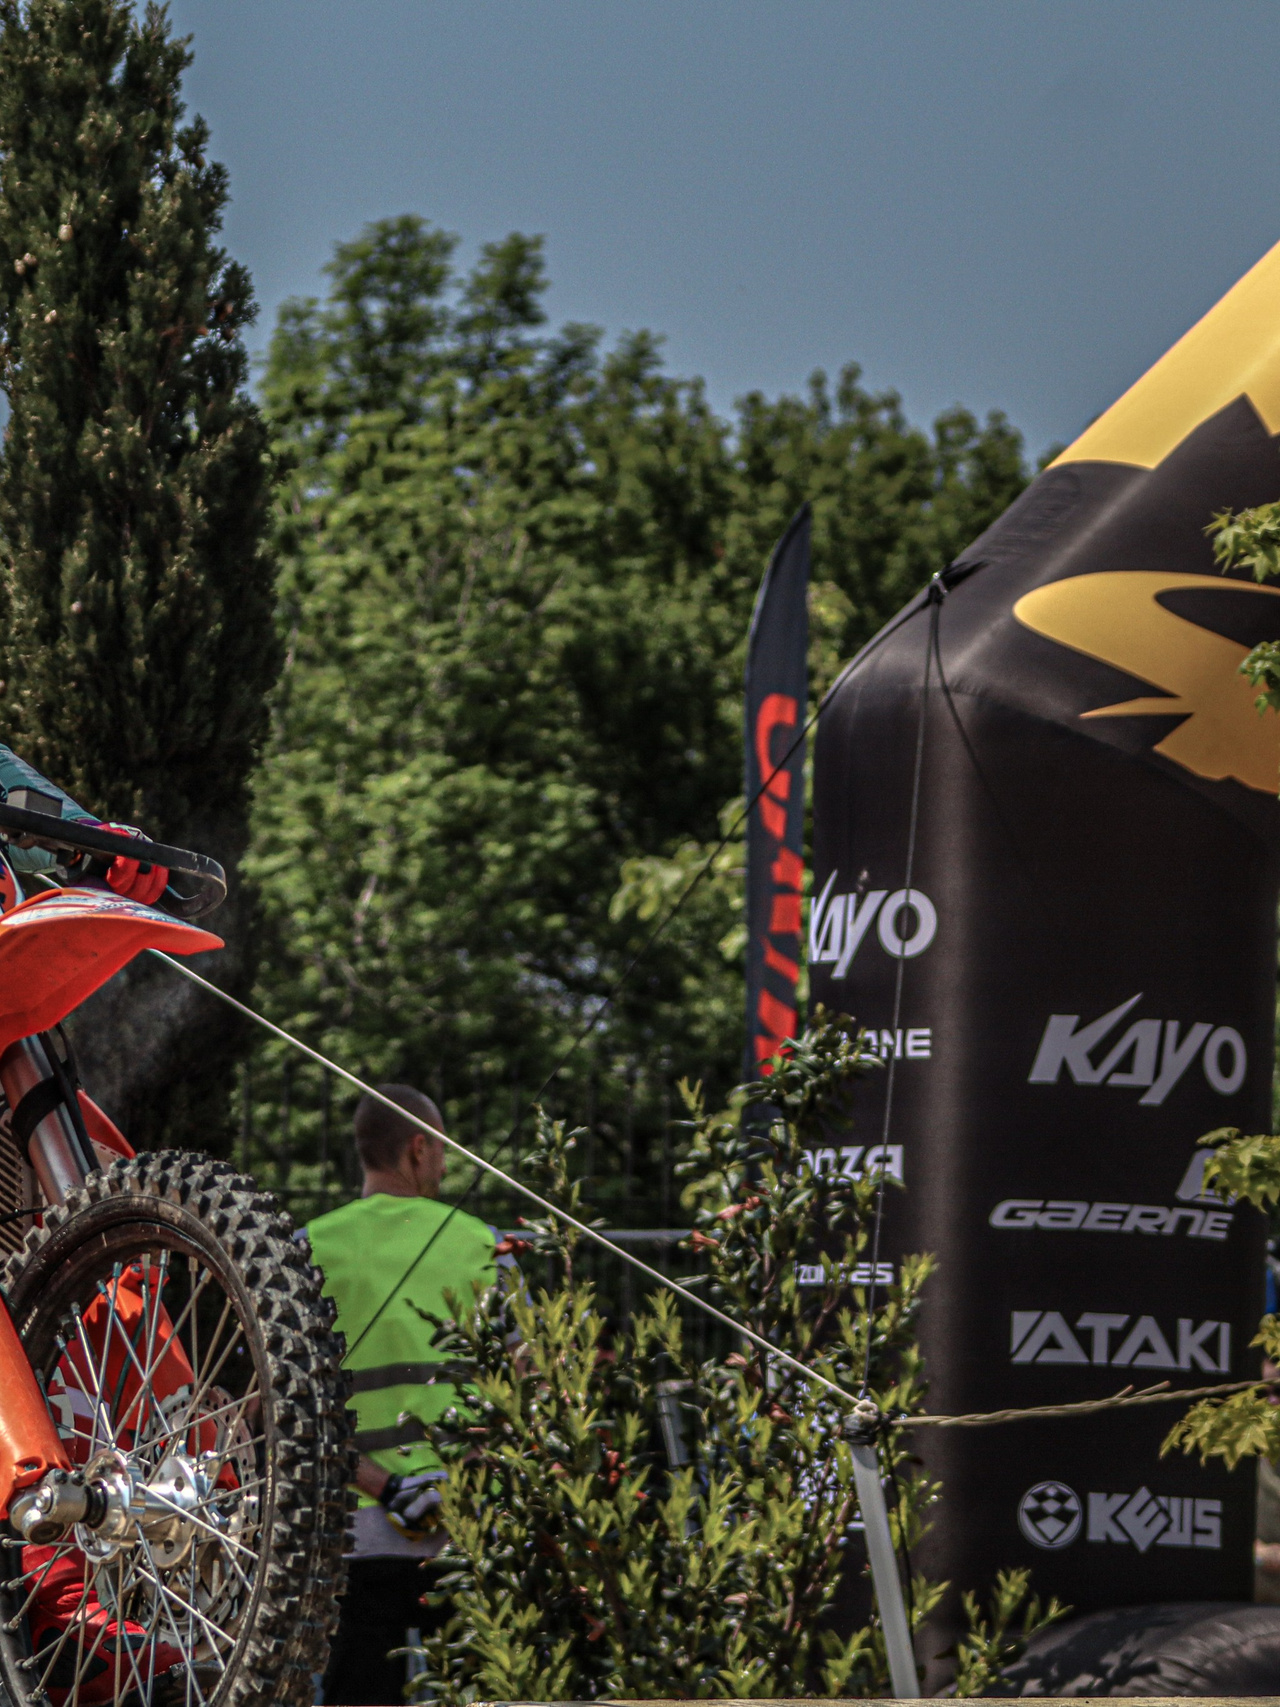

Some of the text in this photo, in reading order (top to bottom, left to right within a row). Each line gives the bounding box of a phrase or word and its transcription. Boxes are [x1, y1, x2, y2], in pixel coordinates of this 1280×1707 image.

[1027, 992, 1247, 1105] KAYO
[989, 1198, 1234, 1240] GAERNE
[1010, 1310, 1231, 1374] ATAKI
